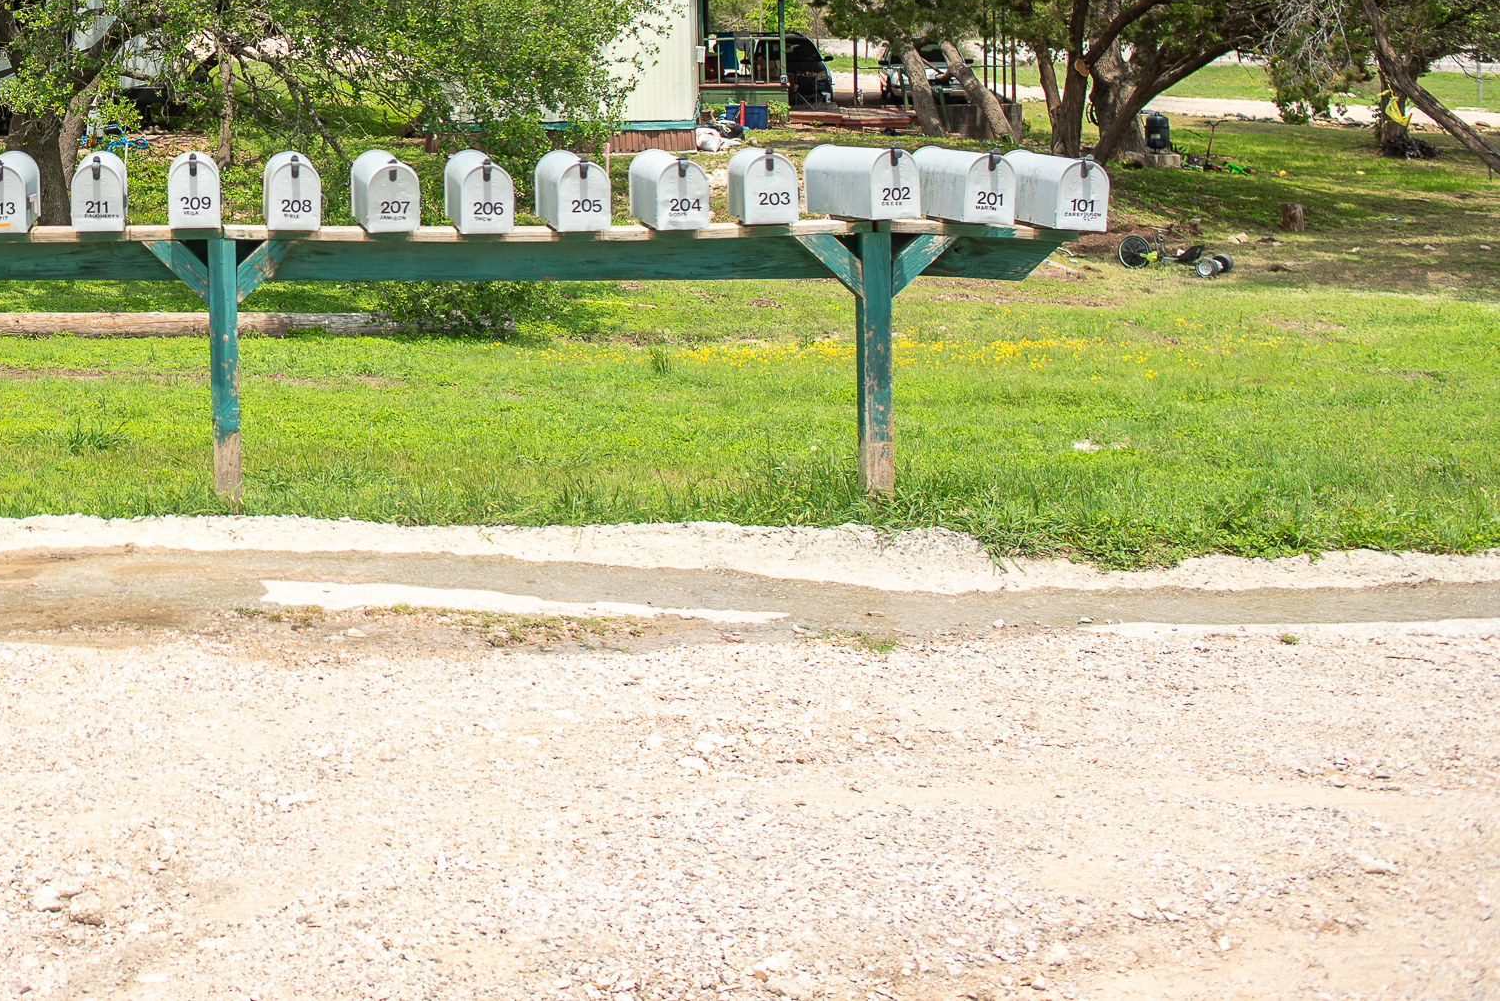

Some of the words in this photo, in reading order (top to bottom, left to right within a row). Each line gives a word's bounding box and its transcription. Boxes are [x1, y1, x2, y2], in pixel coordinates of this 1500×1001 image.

[758, 192, 791, 205] 203
[882, 186, 911, 201] 202
[977, 191, 1003, 206] 201
[85, 200, 108, 213] 211
[180, 196, 211, 210] 209
[281, 199, 312, 213] 208
[381, 201, 410, 214] 207
[473, 200, 503, 215] 206
[571, 198, 602, 212] 205
[670, 198, 701, 211] 204
[1070, 198, 1095, 212] 101
